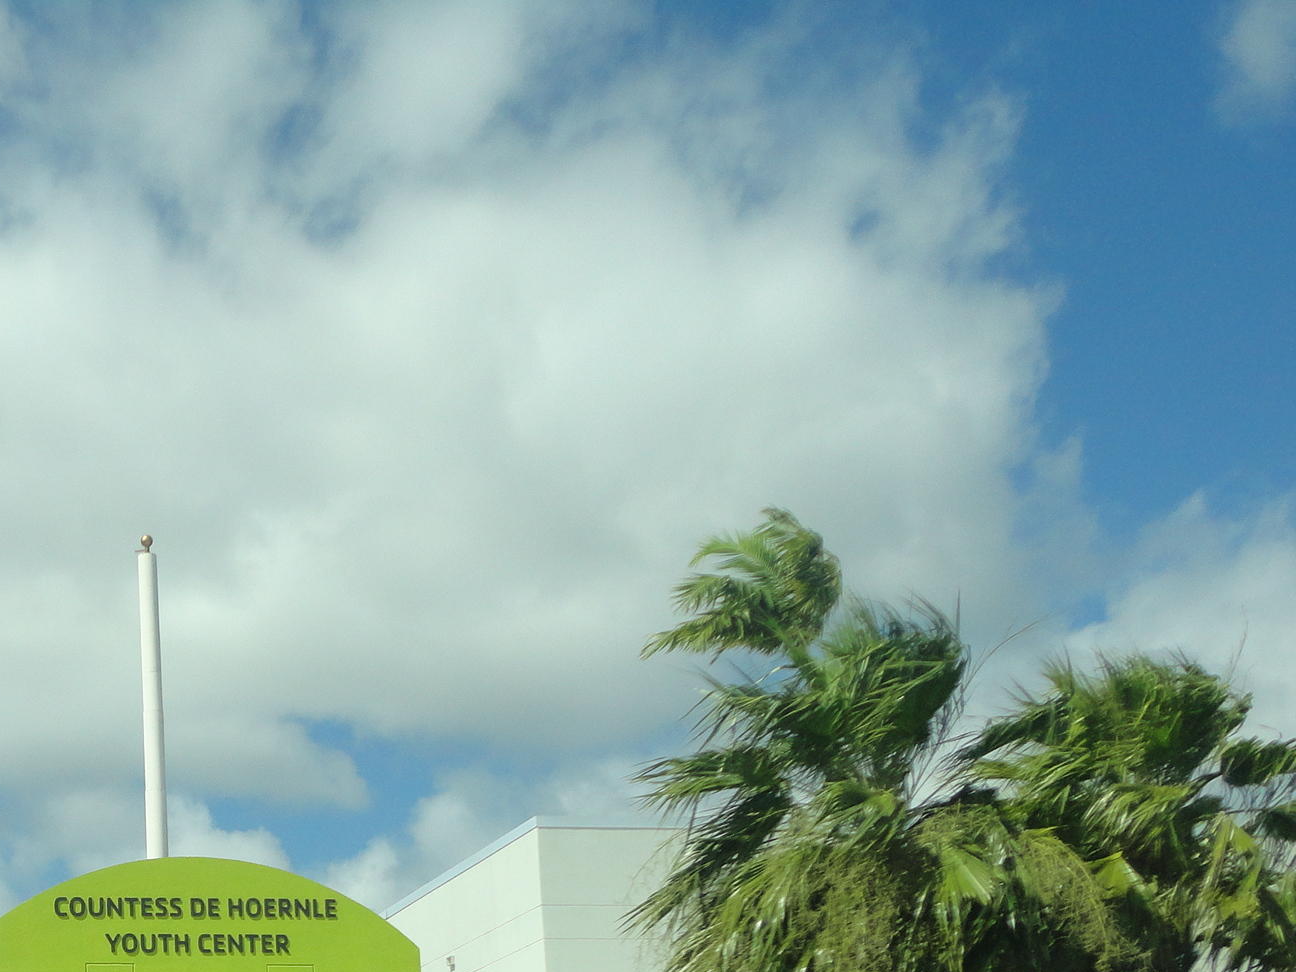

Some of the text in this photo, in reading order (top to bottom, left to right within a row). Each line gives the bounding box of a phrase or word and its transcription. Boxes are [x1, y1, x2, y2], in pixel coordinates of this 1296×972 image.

[54, 896, 338, 919] COUNTESS DE HOERNLE
[105, 933, 290, 955] YOUTH CENTER
